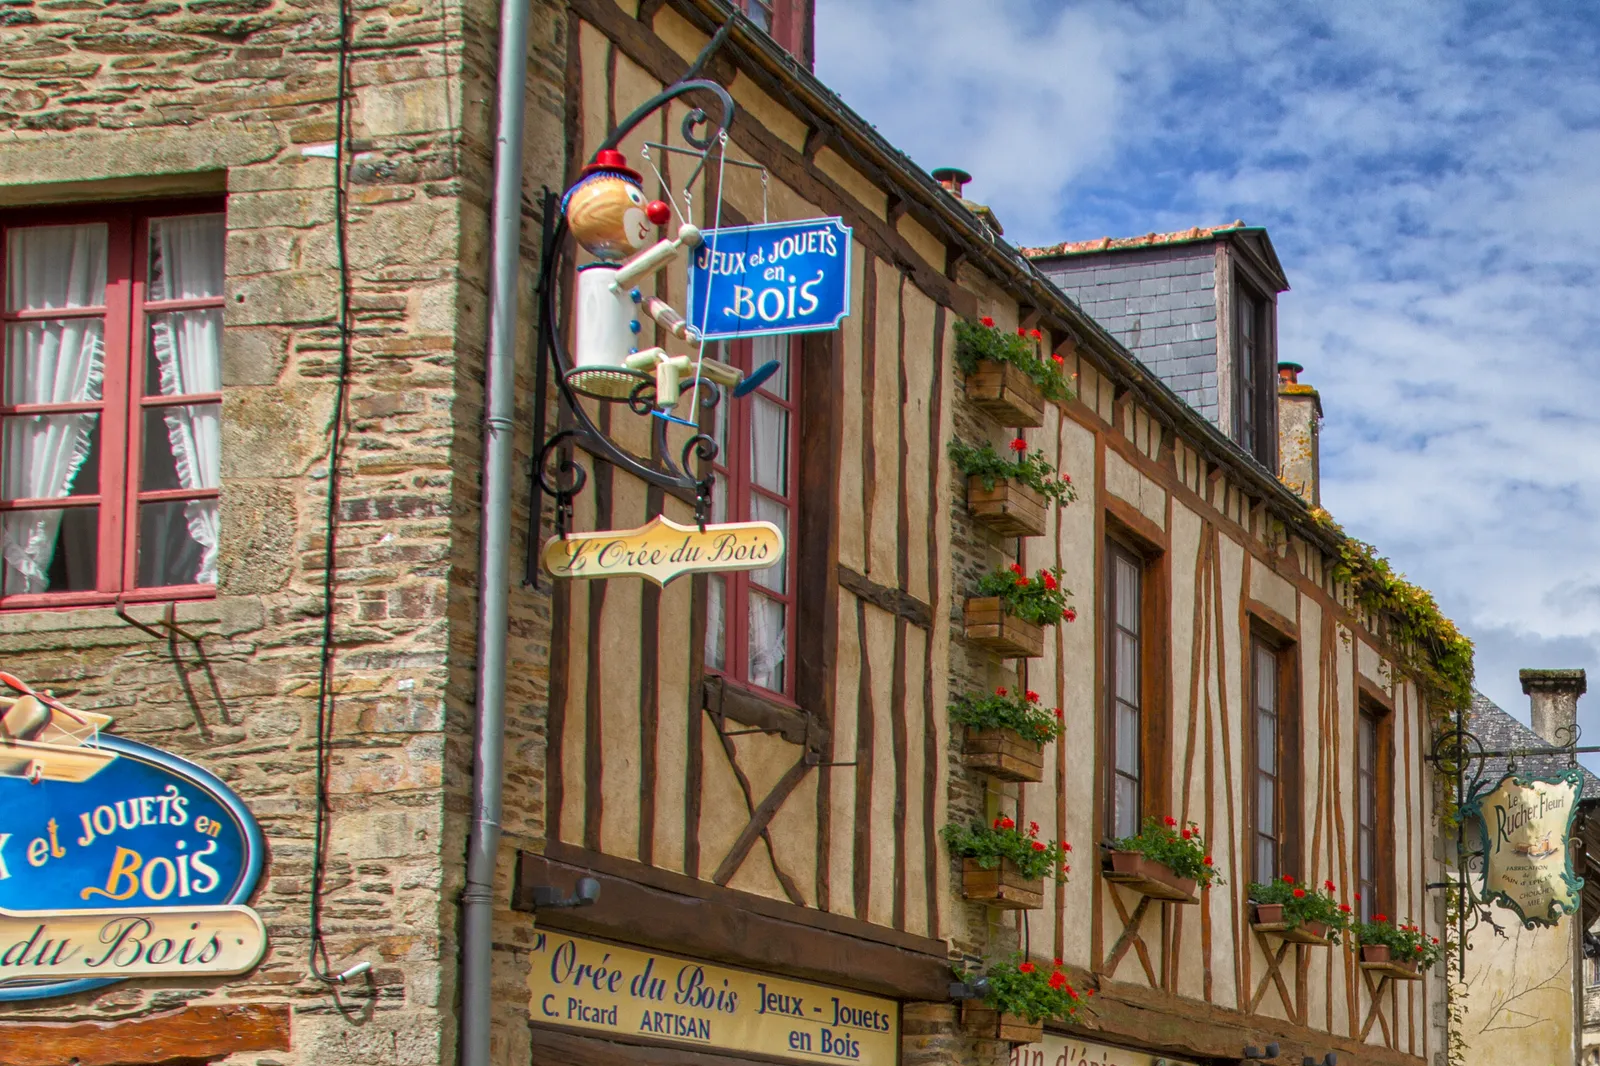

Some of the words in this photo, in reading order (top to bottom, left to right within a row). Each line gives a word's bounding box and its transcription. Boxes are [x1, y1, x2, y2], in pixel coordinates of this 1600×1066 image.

[699, 247, 746, 276] JEUX
[749, 246, 765, 267] et
[768, 226, 837, 264] JOUETS
[764, 266, 785, 282] en
[557, 536, 667, 571] L'Orée
[669, 536, 704, 563] du
[707, 533, 768, 561] Bois
[27, 817, 66, 867] et
[77, 784, 189, 847] JOUETS
[194, 815, 222, 837] en
[1494, 805, 1538, 854] Rucher
[1540, 792, 1564, 819] Fleuri
[1508, 794, 1518, 809] Le
[0, 924, 80, 966] du
[85, 916, 221, 967] Bois
[630, 958, 667, 1001] du
[674, 964, 739, 1014] Bois
[756, 983, 804, 1016] Jeux
[831, 997, 890, 1032] Jouets
[542, 994, 560, 1018] C.
[567, 998, 618, 1027] Picard
[640, 1010, 711, 1040] ARTISAN
[789, 1030, 812, 1051] en
[821, 1029, 860, 1059] Bois
